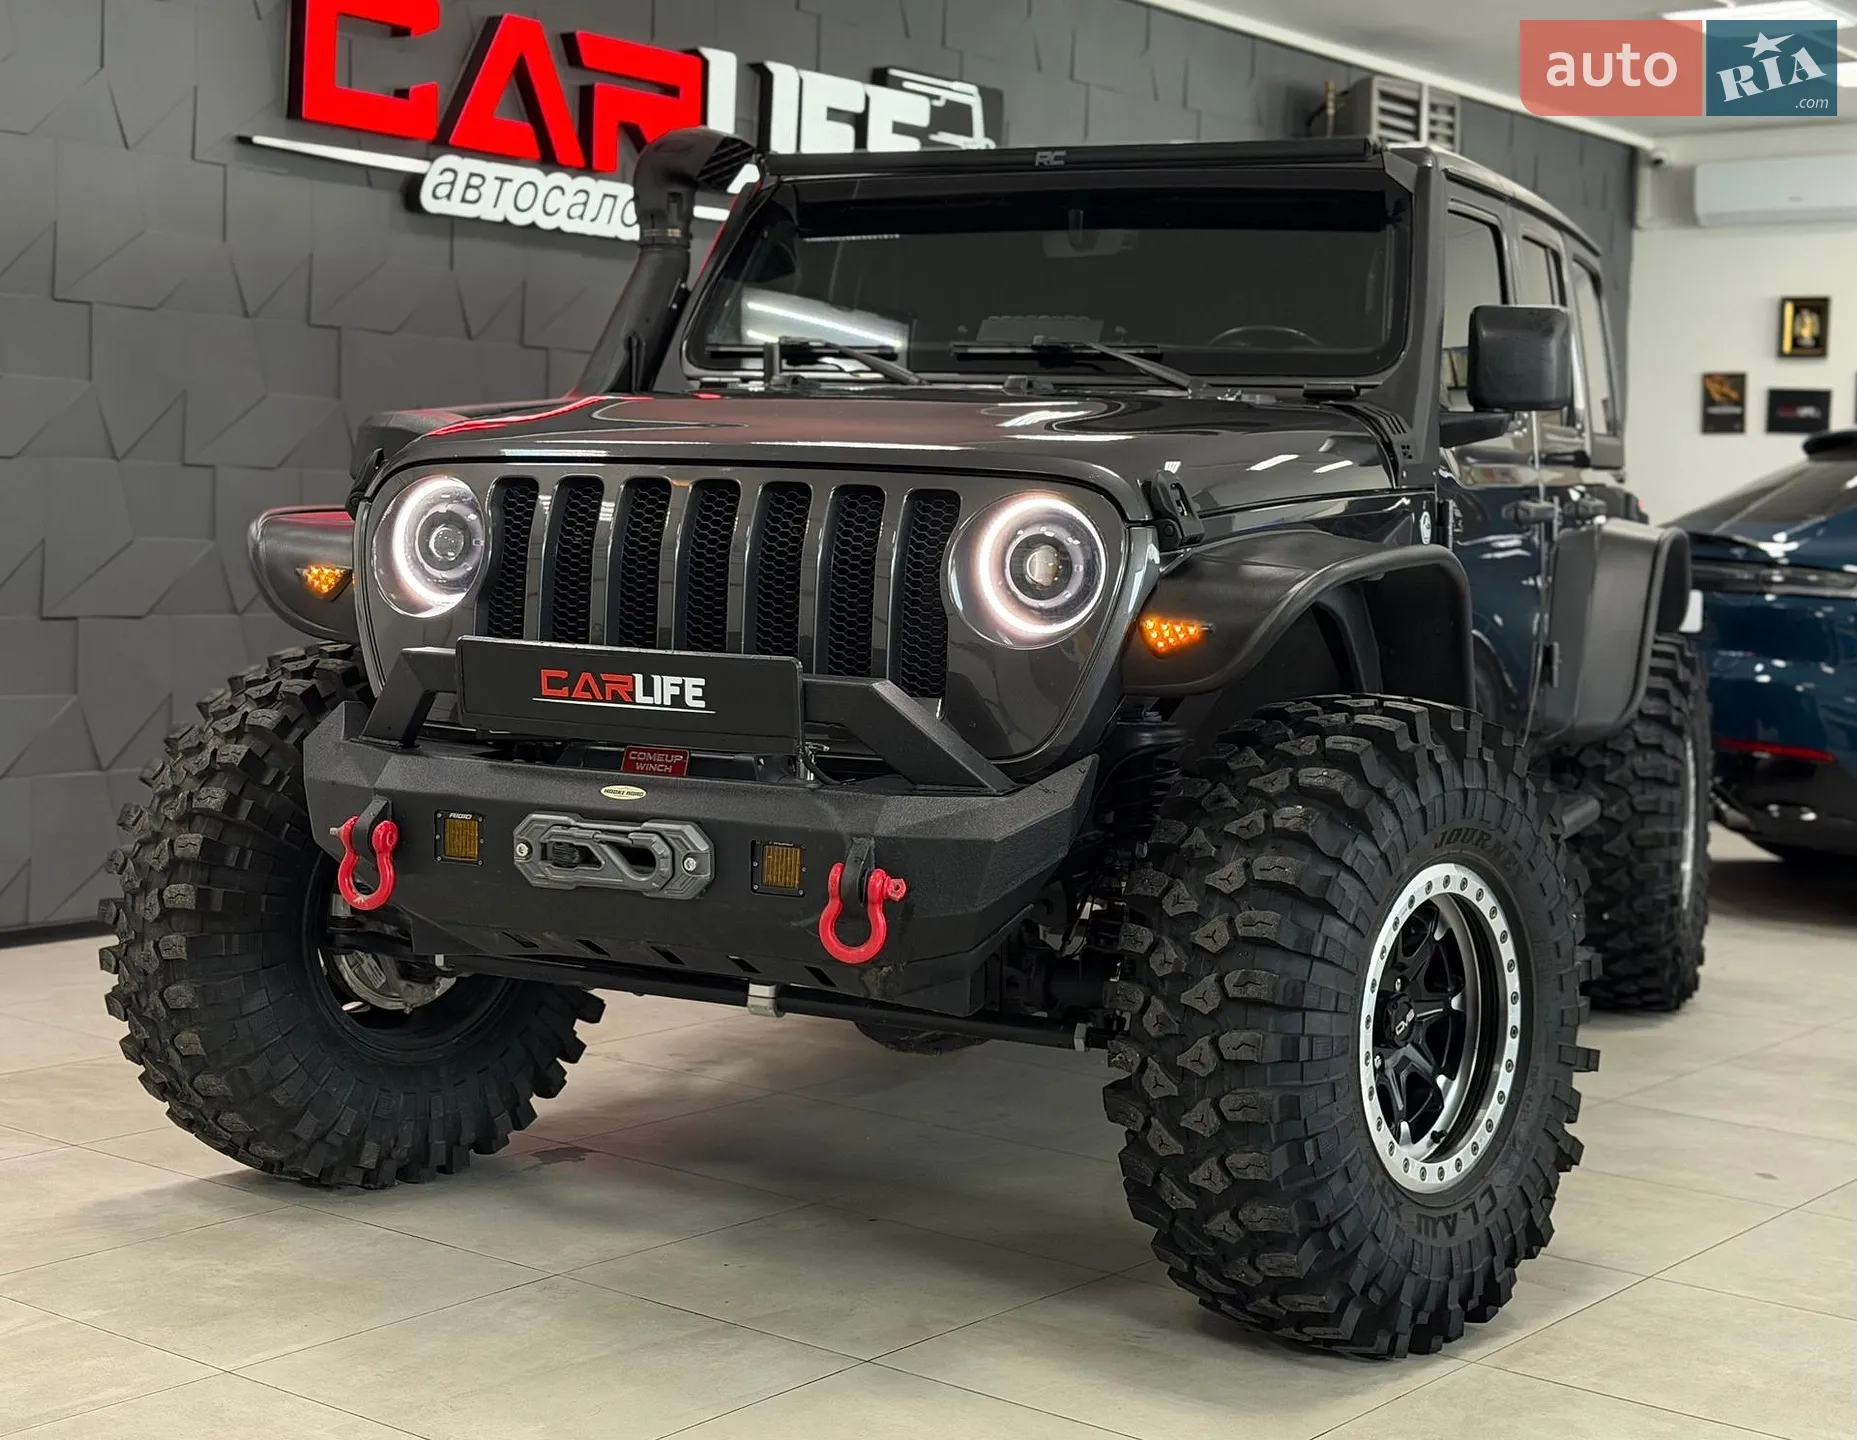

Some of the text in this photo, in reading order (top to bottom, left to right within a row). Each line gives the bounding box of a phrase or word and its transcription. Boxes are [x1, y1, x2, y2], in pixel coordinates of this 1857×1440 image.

[1035, 150, 1067, 166] RC
[431, 166, 638, 228] автосало
[540, 668, 706, 708] CARLIFE
[629, 751, 684, 763] COMEUP
[635, 762, 672, 773] WINCH
